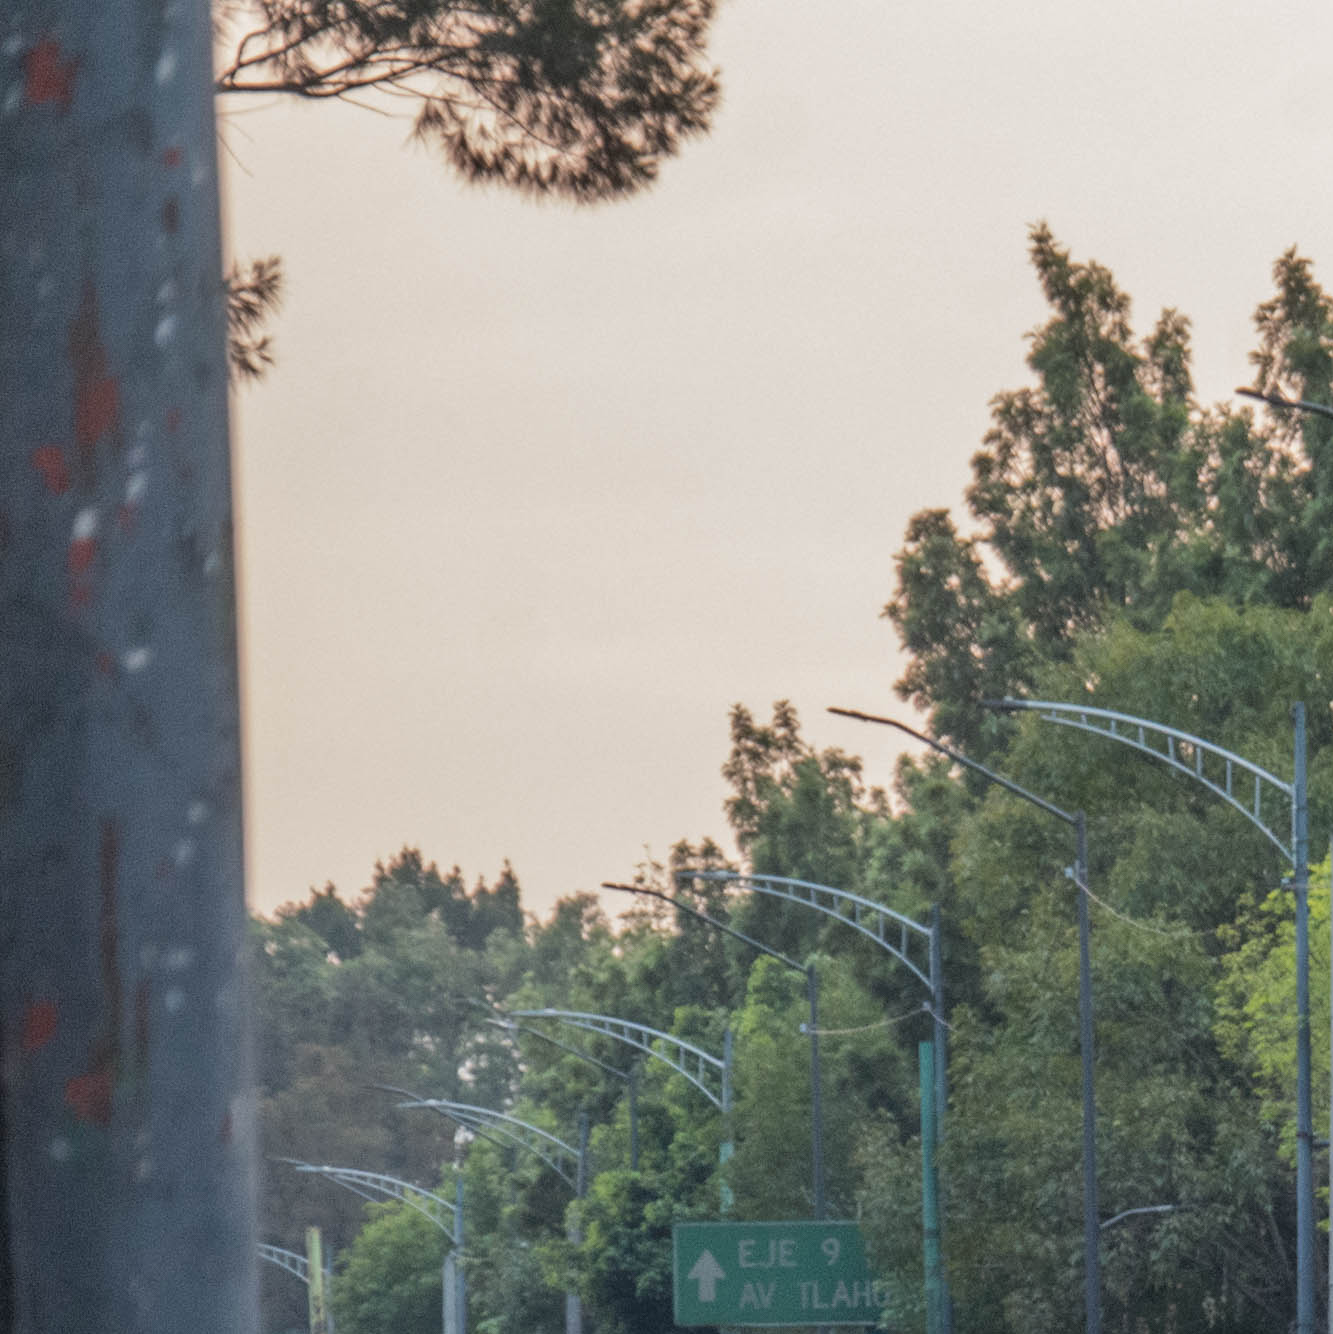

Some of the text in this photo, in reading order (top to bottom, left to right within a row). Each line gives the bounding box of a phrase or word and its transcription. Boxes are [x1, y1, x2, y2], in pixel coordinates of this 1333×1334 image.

[738, 1238, 798, 1269] EJE
[820, 1236, 841, 1267] 9
[738, 1282, 778, 1310] AV
